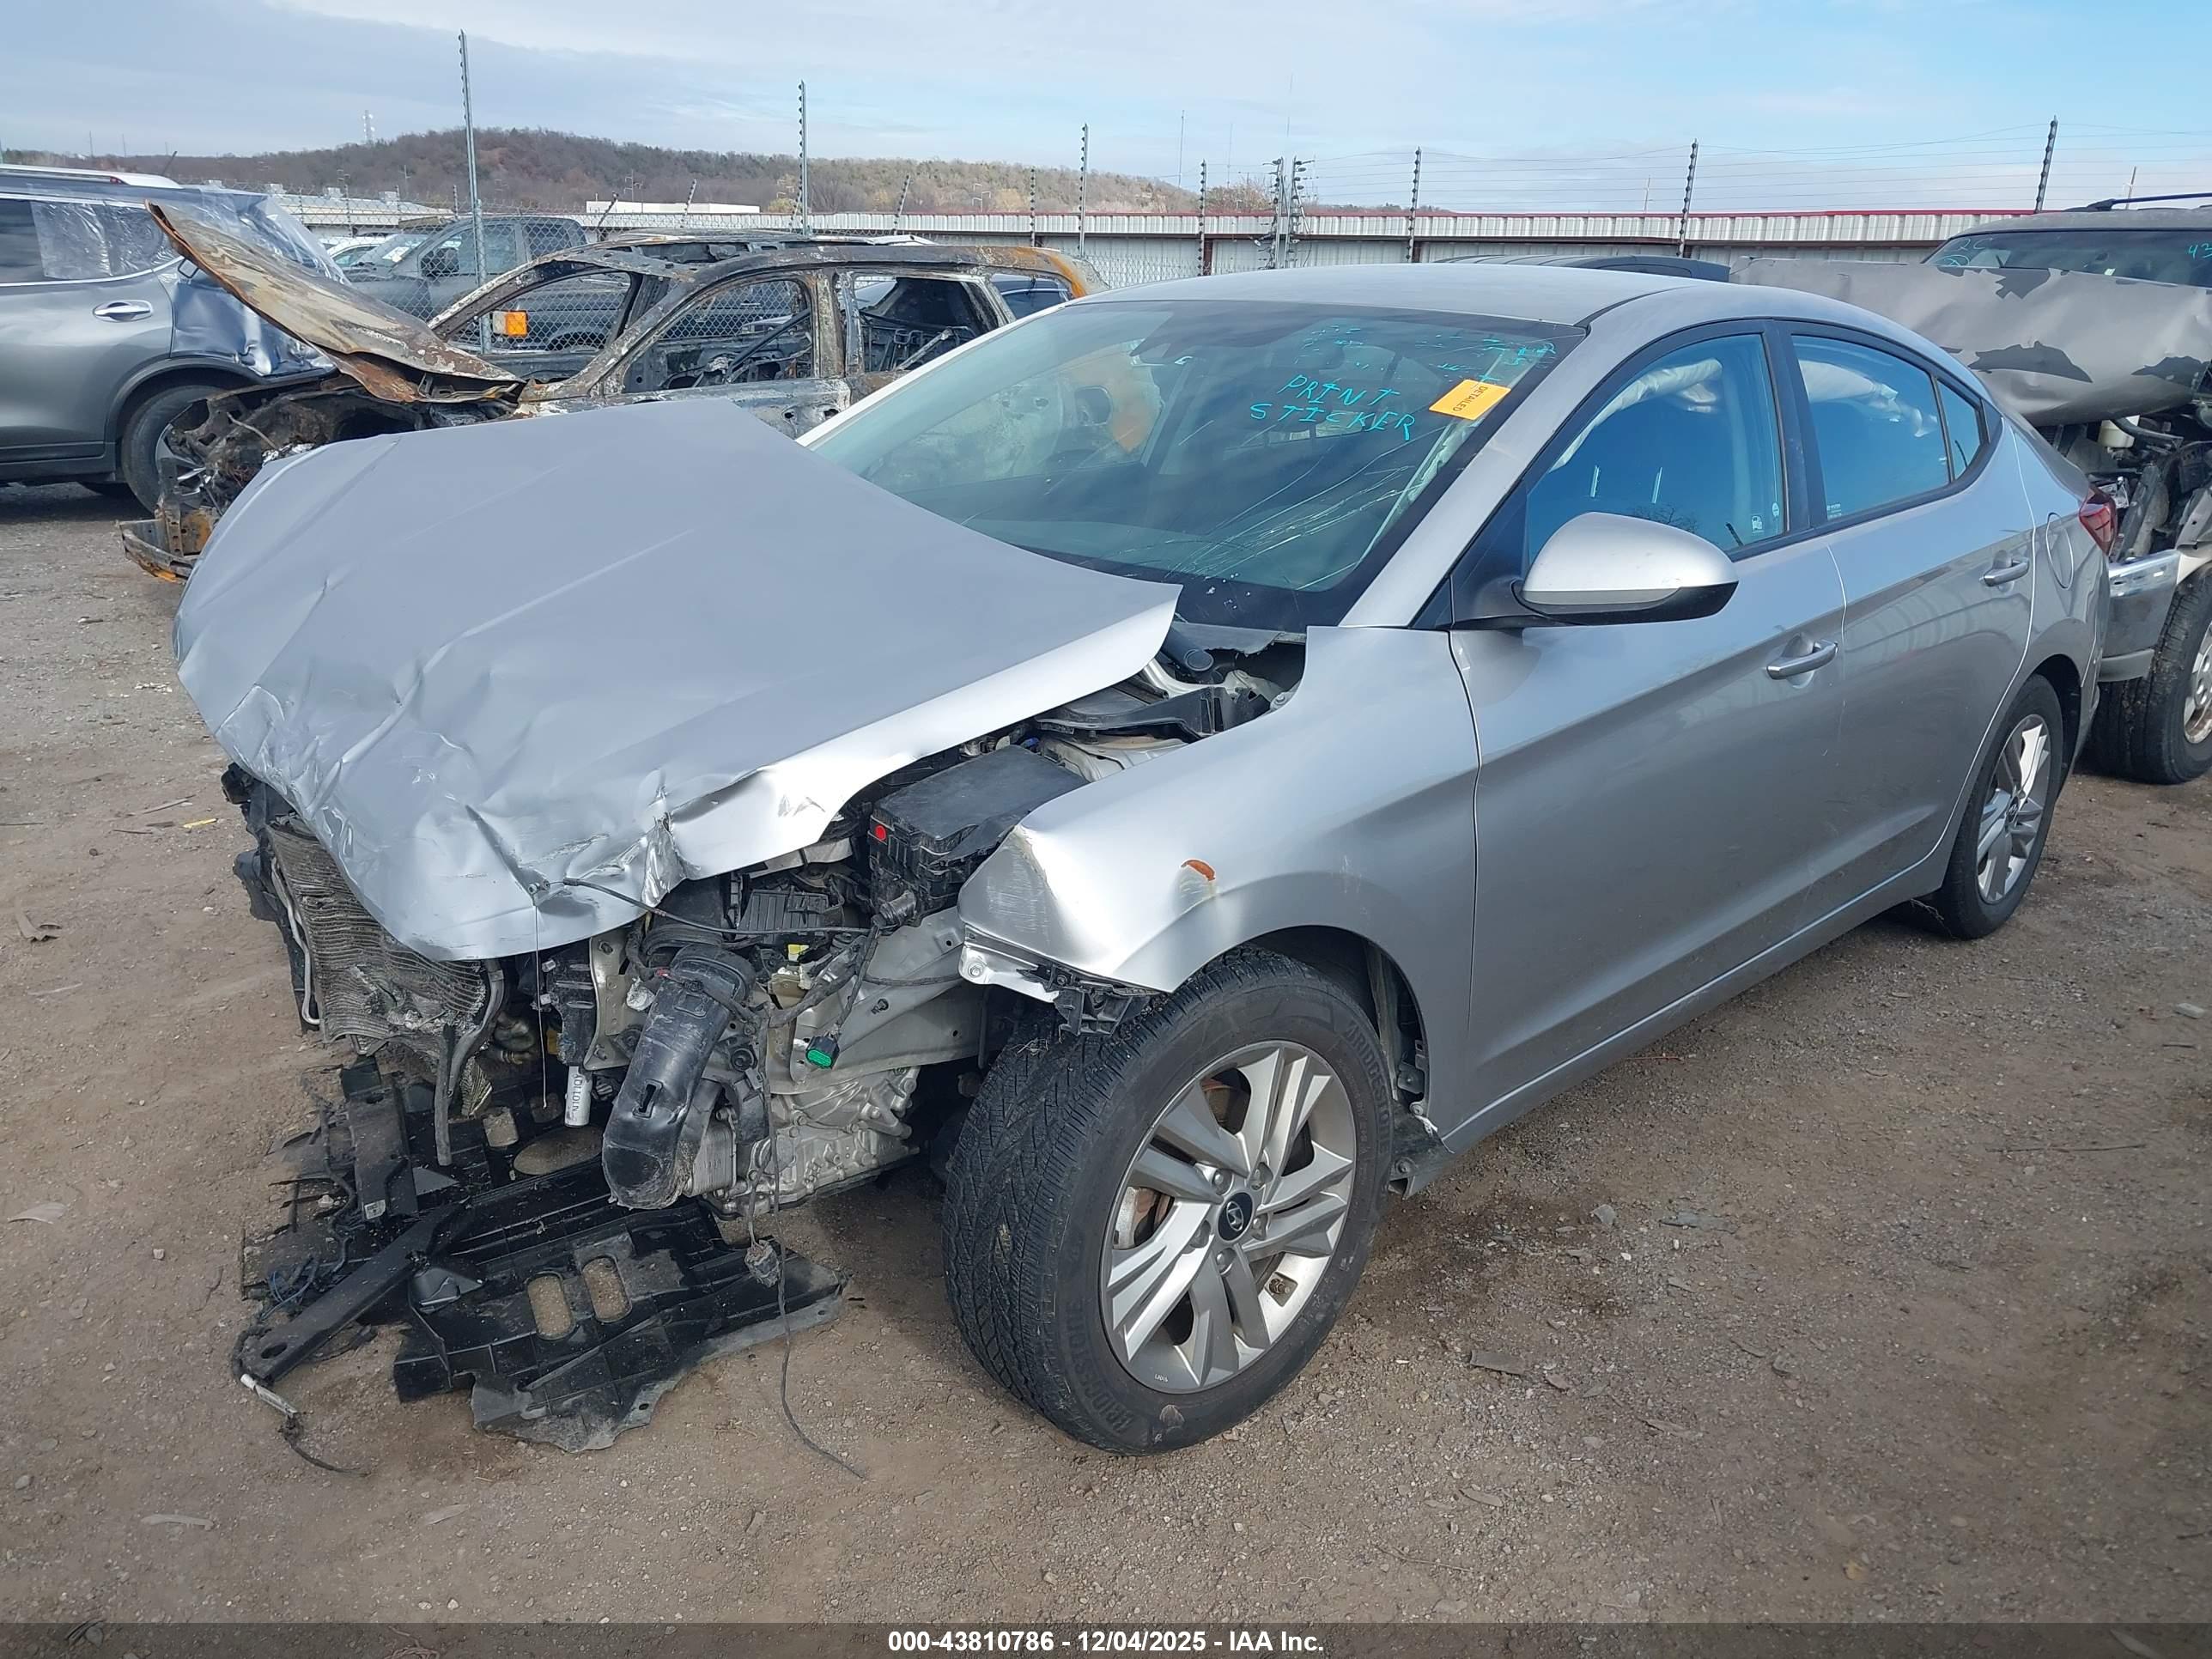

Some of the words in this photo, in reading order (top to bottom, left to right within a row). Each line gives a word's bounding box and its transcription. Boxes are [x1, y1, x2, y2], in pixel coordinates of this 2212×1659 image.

[1276, 374, 1401, 407] PRINT
[1452, 386, 1489, 412] DETAILED
[1249, 403, 1416, 441] STICKER
